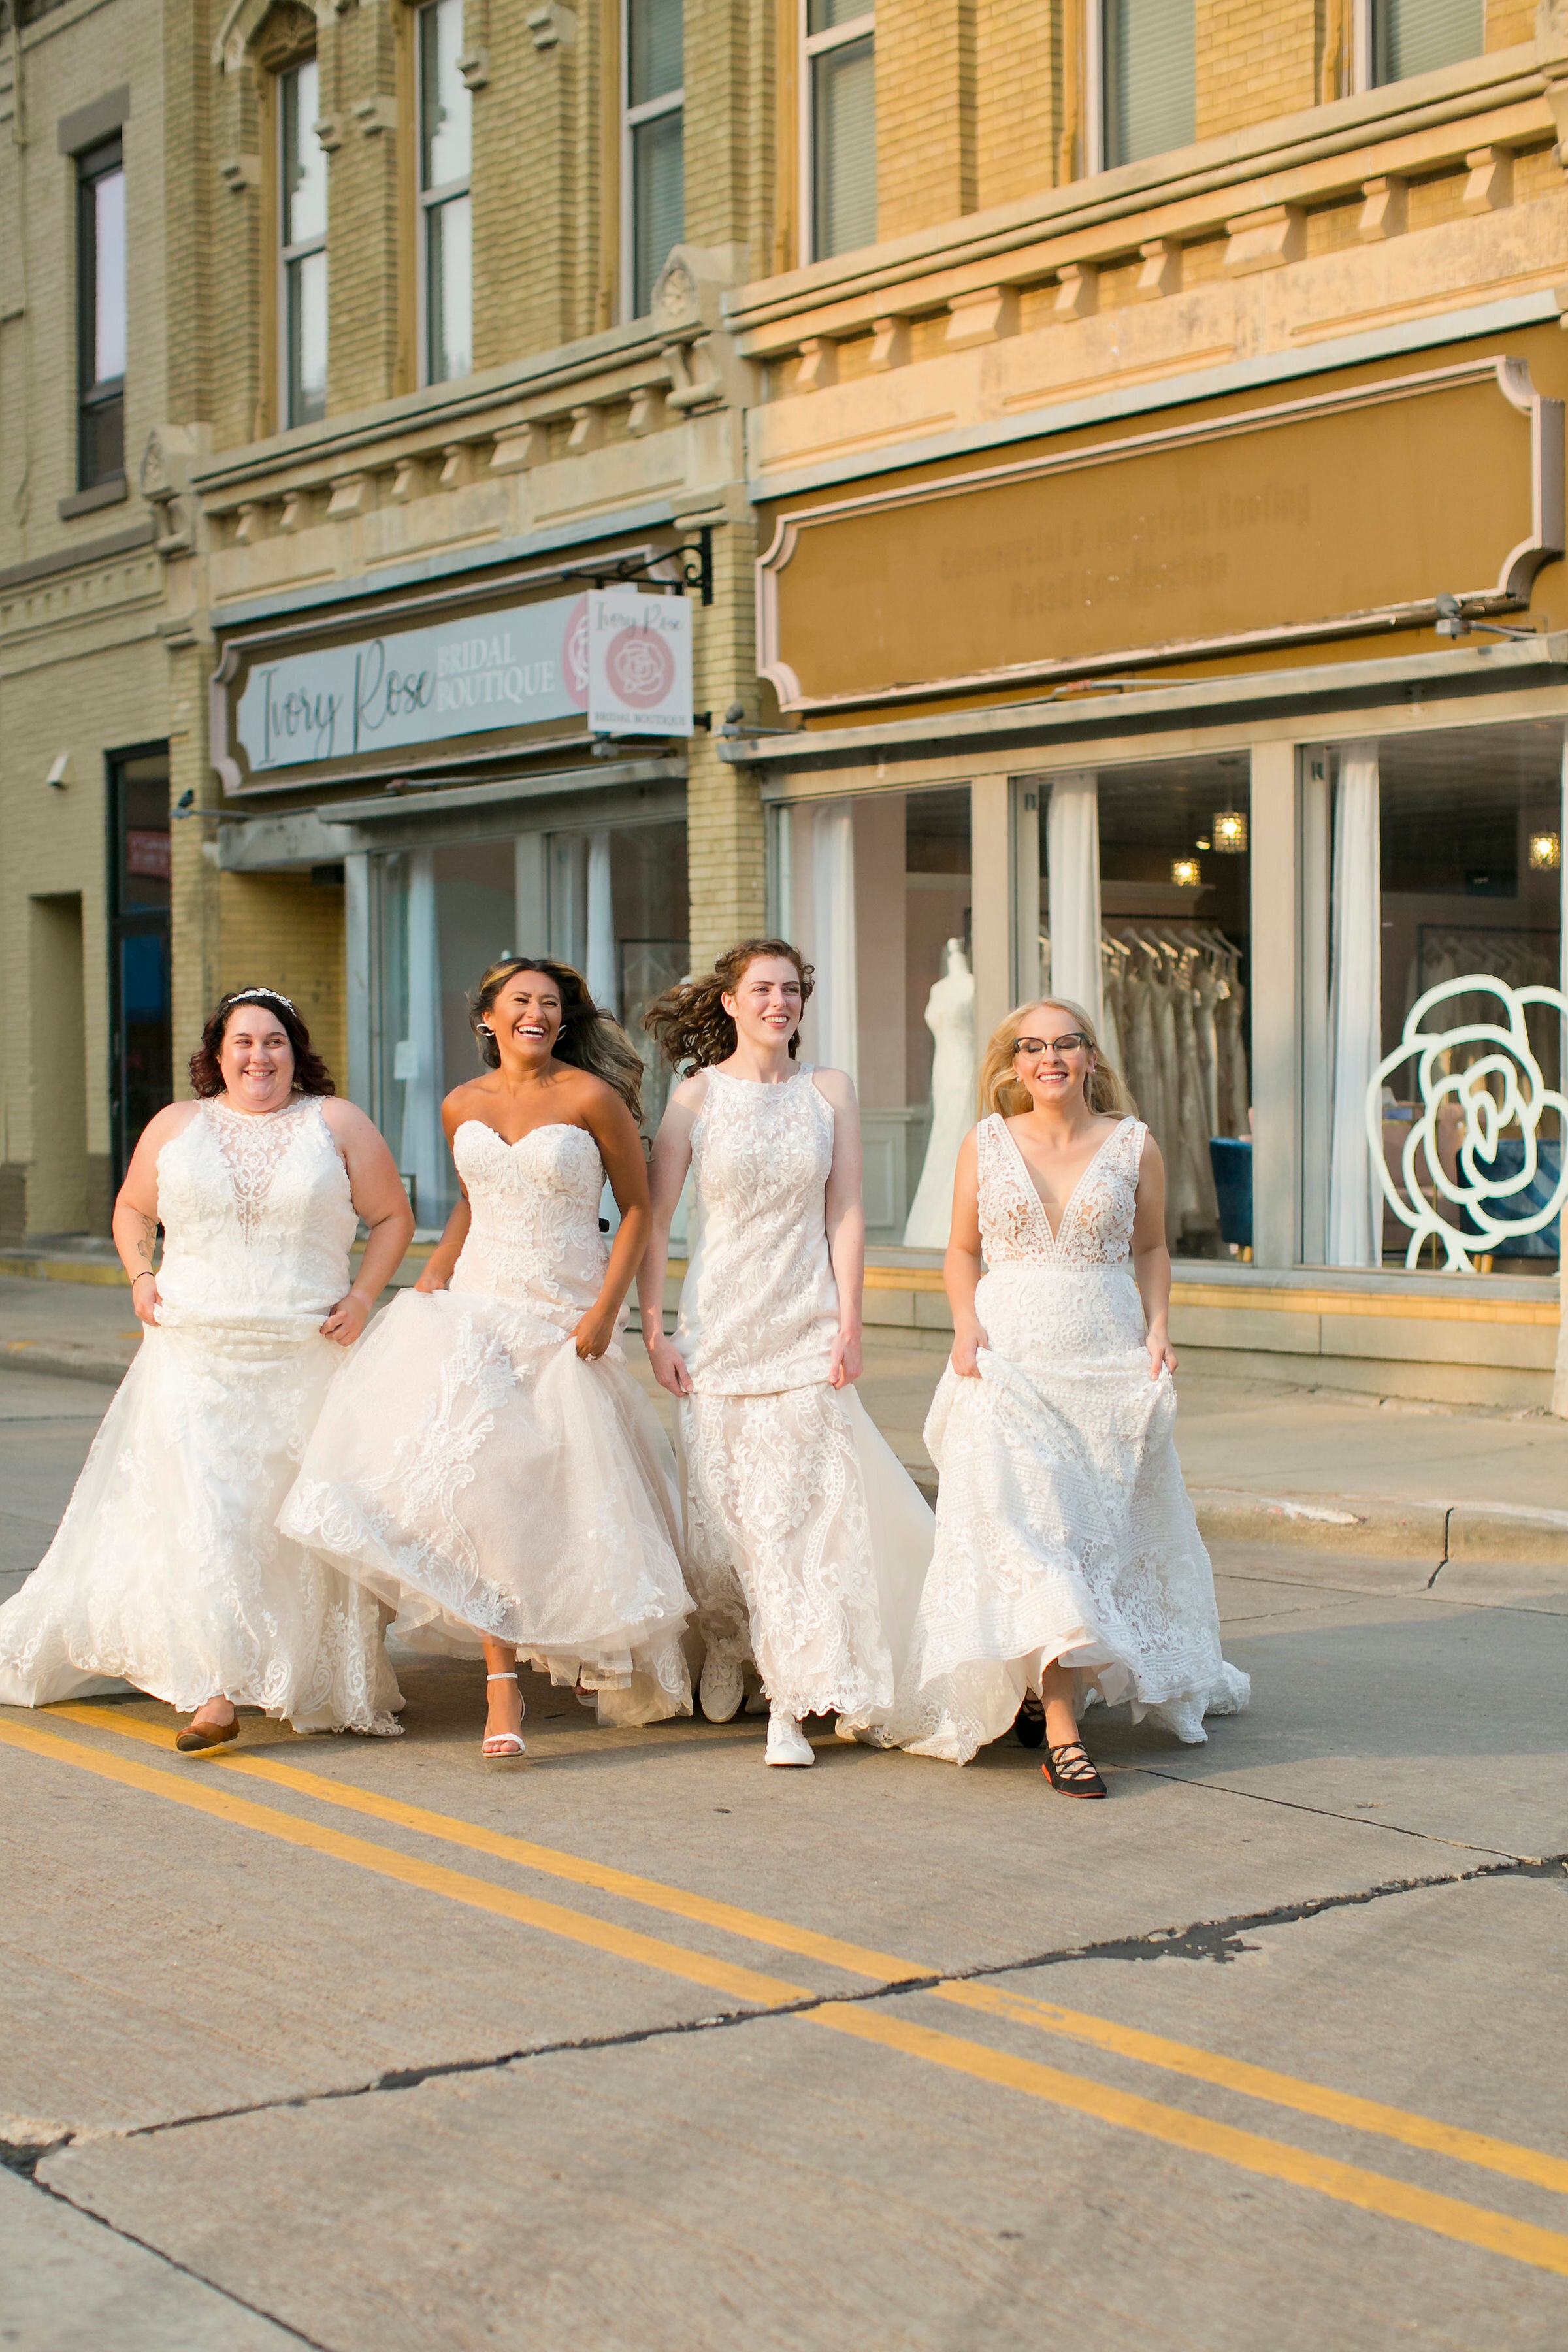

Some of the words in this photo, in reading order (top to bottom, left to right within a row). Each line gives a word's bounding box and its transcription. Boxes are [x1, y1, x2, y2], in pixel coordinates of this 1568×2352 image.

[596, 601, 638, 638] Ivory
[643, 603, 683, 634] Rose
[437, 632, 517, 677] BRIDAL
[258, 666, 343, 765] Ivory
[353, 637, 437, 754] Rose
[437, 660, 555, 711] BOUTIQUE
